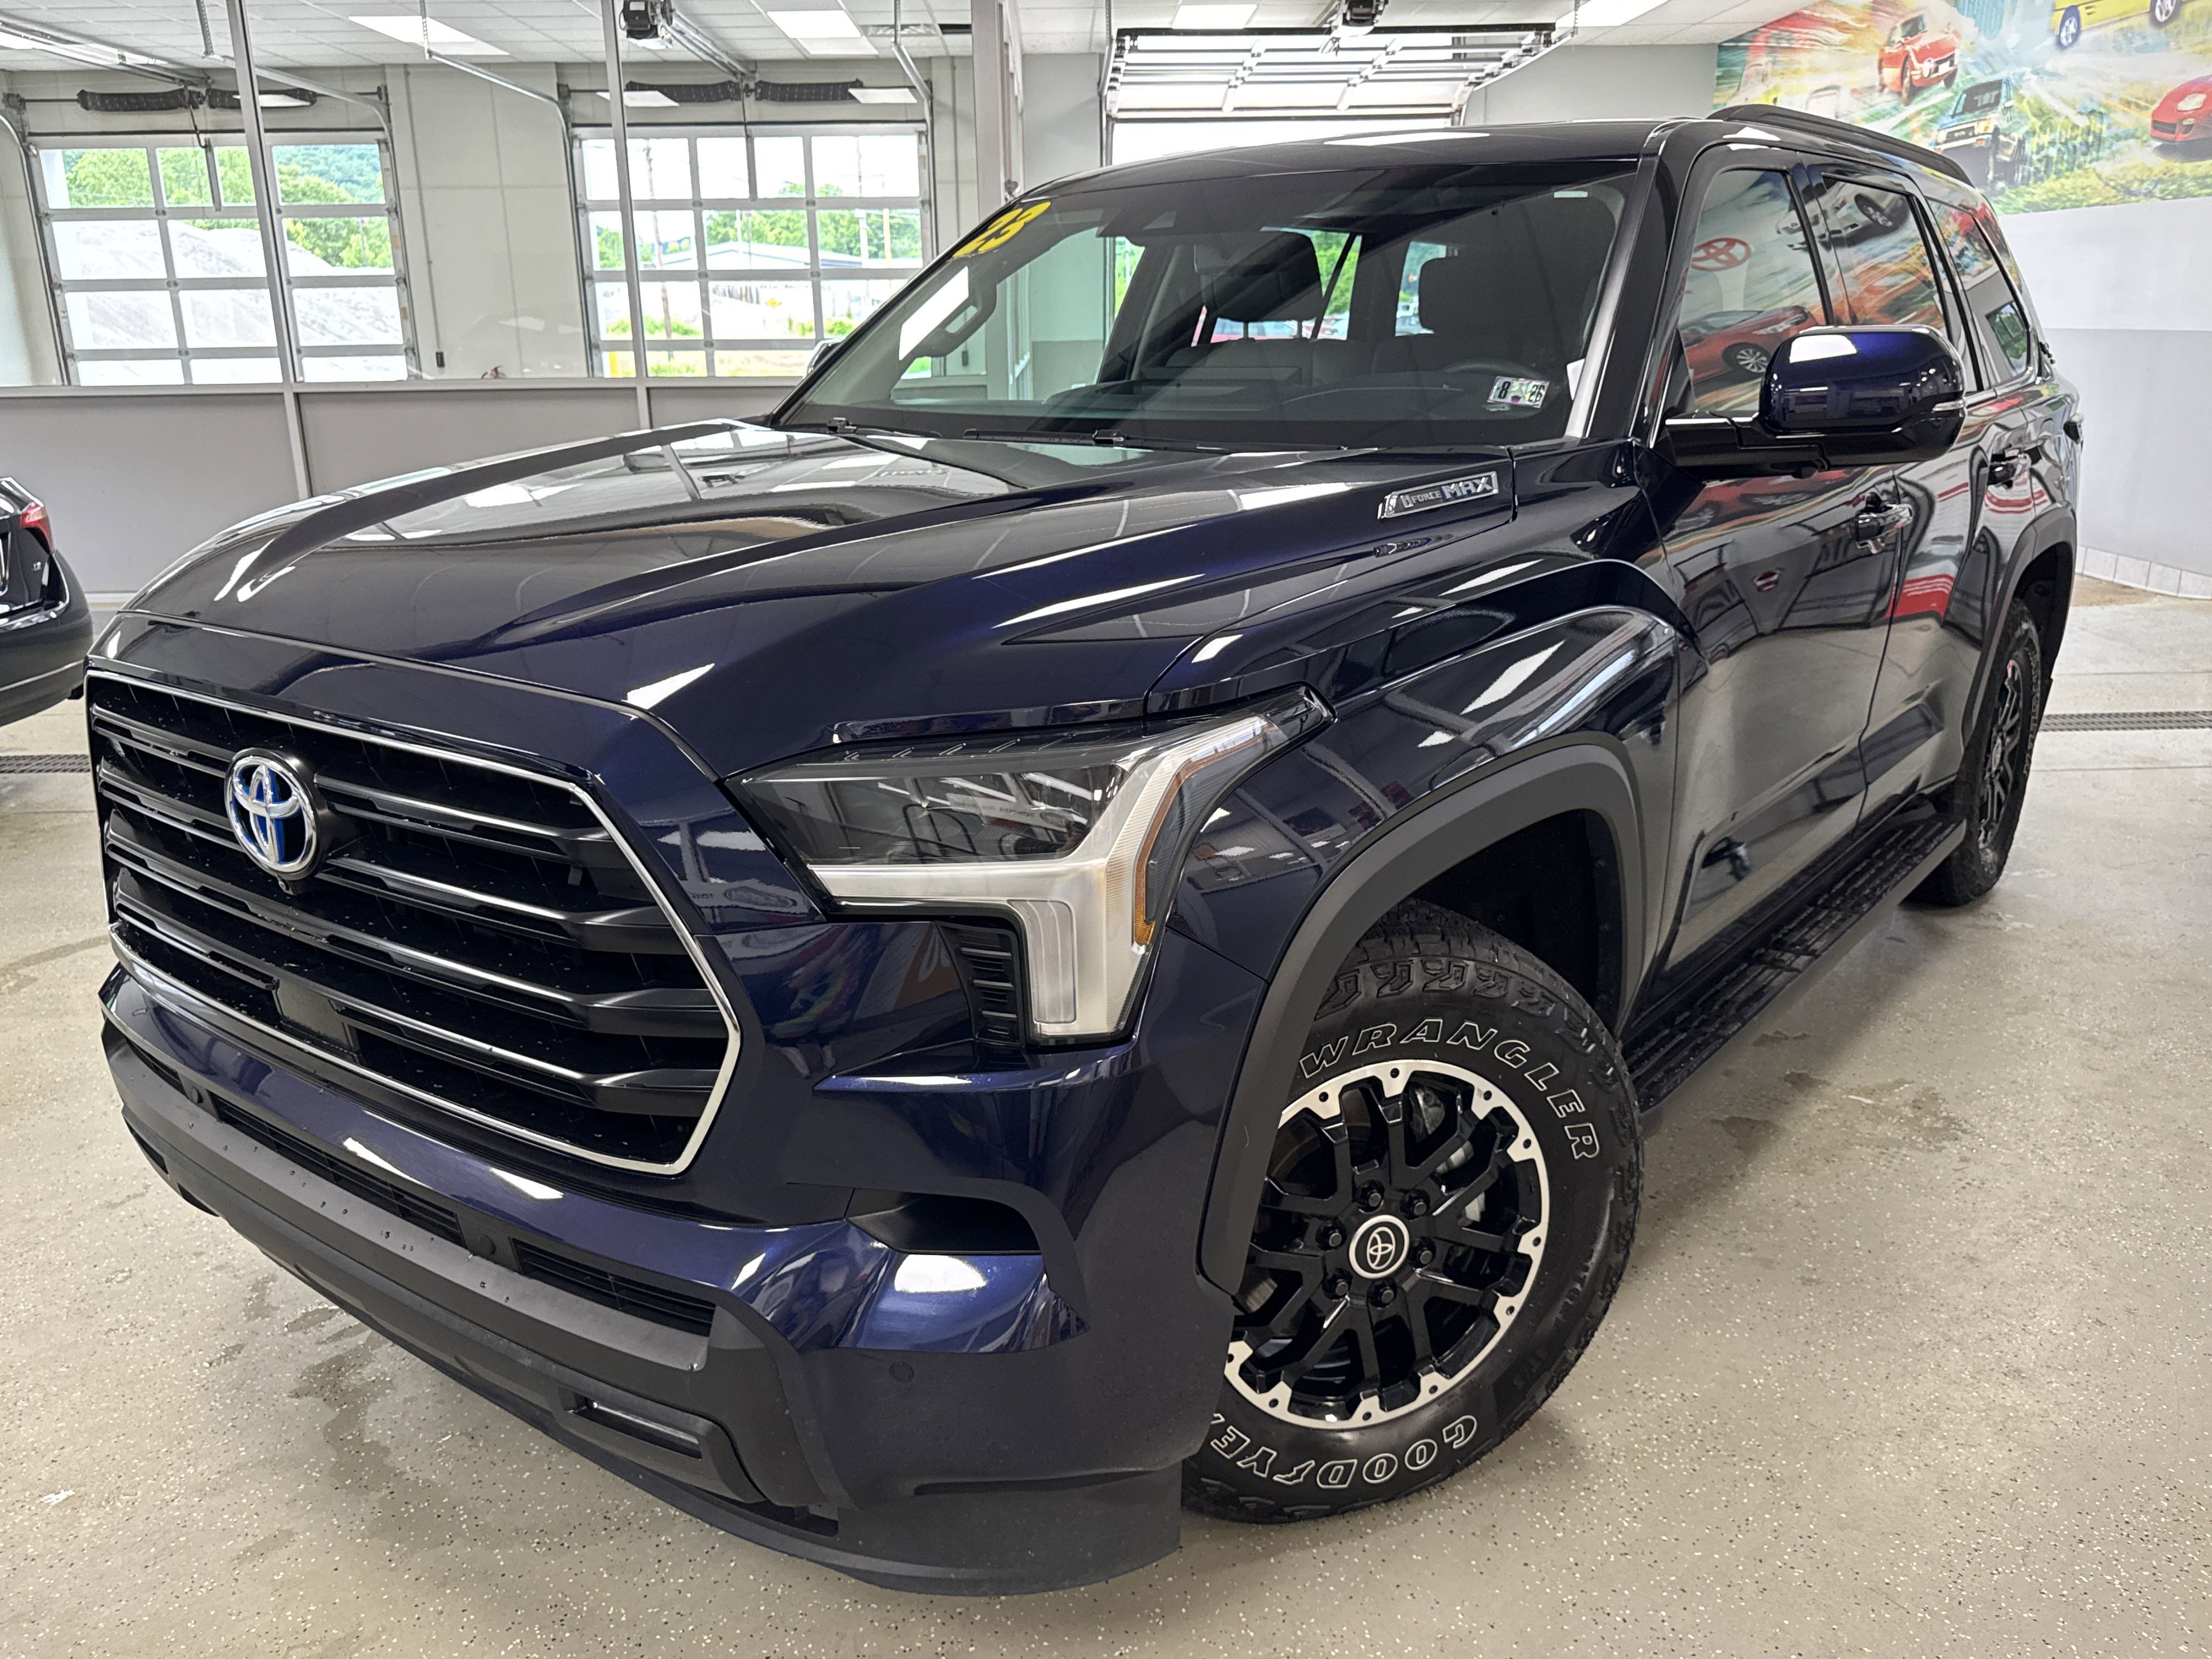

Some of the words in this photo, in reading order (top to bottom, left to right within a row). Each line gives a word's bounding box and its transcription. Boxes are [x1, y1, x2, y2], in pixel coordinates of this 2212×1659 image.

[952, 201, 1052, 259] 23
[1498, 381, 1511, 399] 8
[1441, 476, 1493, 500] MAX
[1299, 1018, 1600, 1160] WRANGLER
